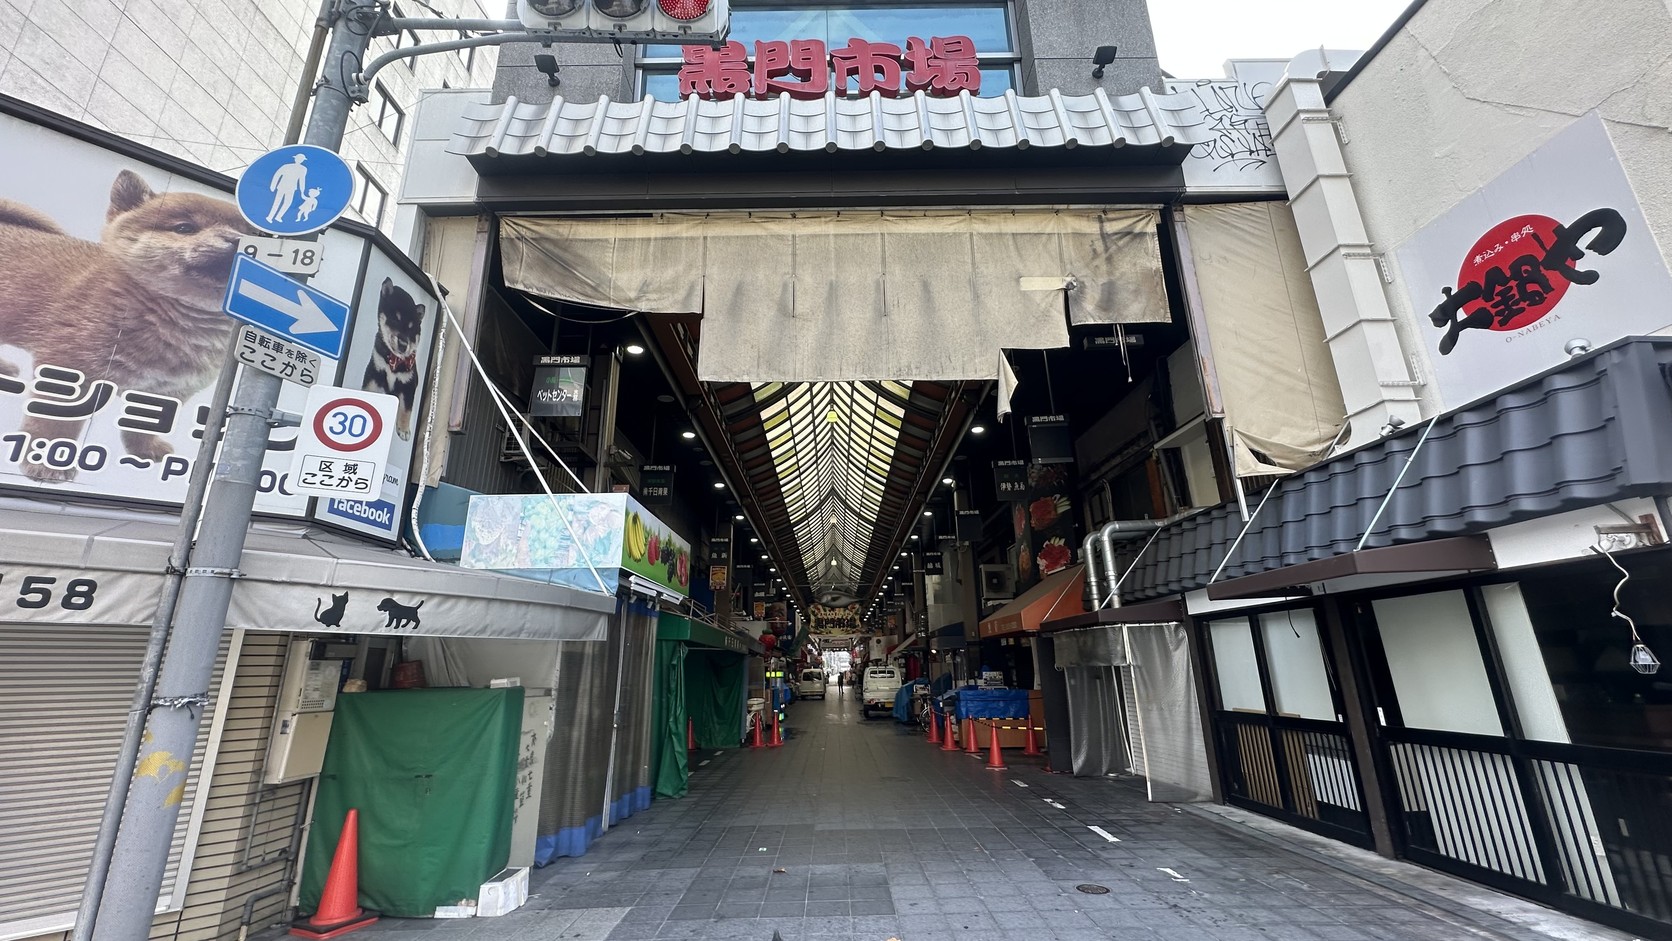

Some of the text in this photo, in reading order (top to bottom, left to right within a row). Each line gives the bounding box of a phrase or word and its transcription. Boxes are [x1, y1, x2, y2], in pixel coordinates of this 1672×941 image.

[677, 35, 981, 100] 黒門市場
[1505, 314, 1561, 343] O-NABEYA
[240, 345, 314, 384] ここから
[244, 330, 317, 368] 自転車を除く
[329, 411, 367, 438] 30
[302, 472, 369, 490] ここから
[0, 573, 98, 611] 58
